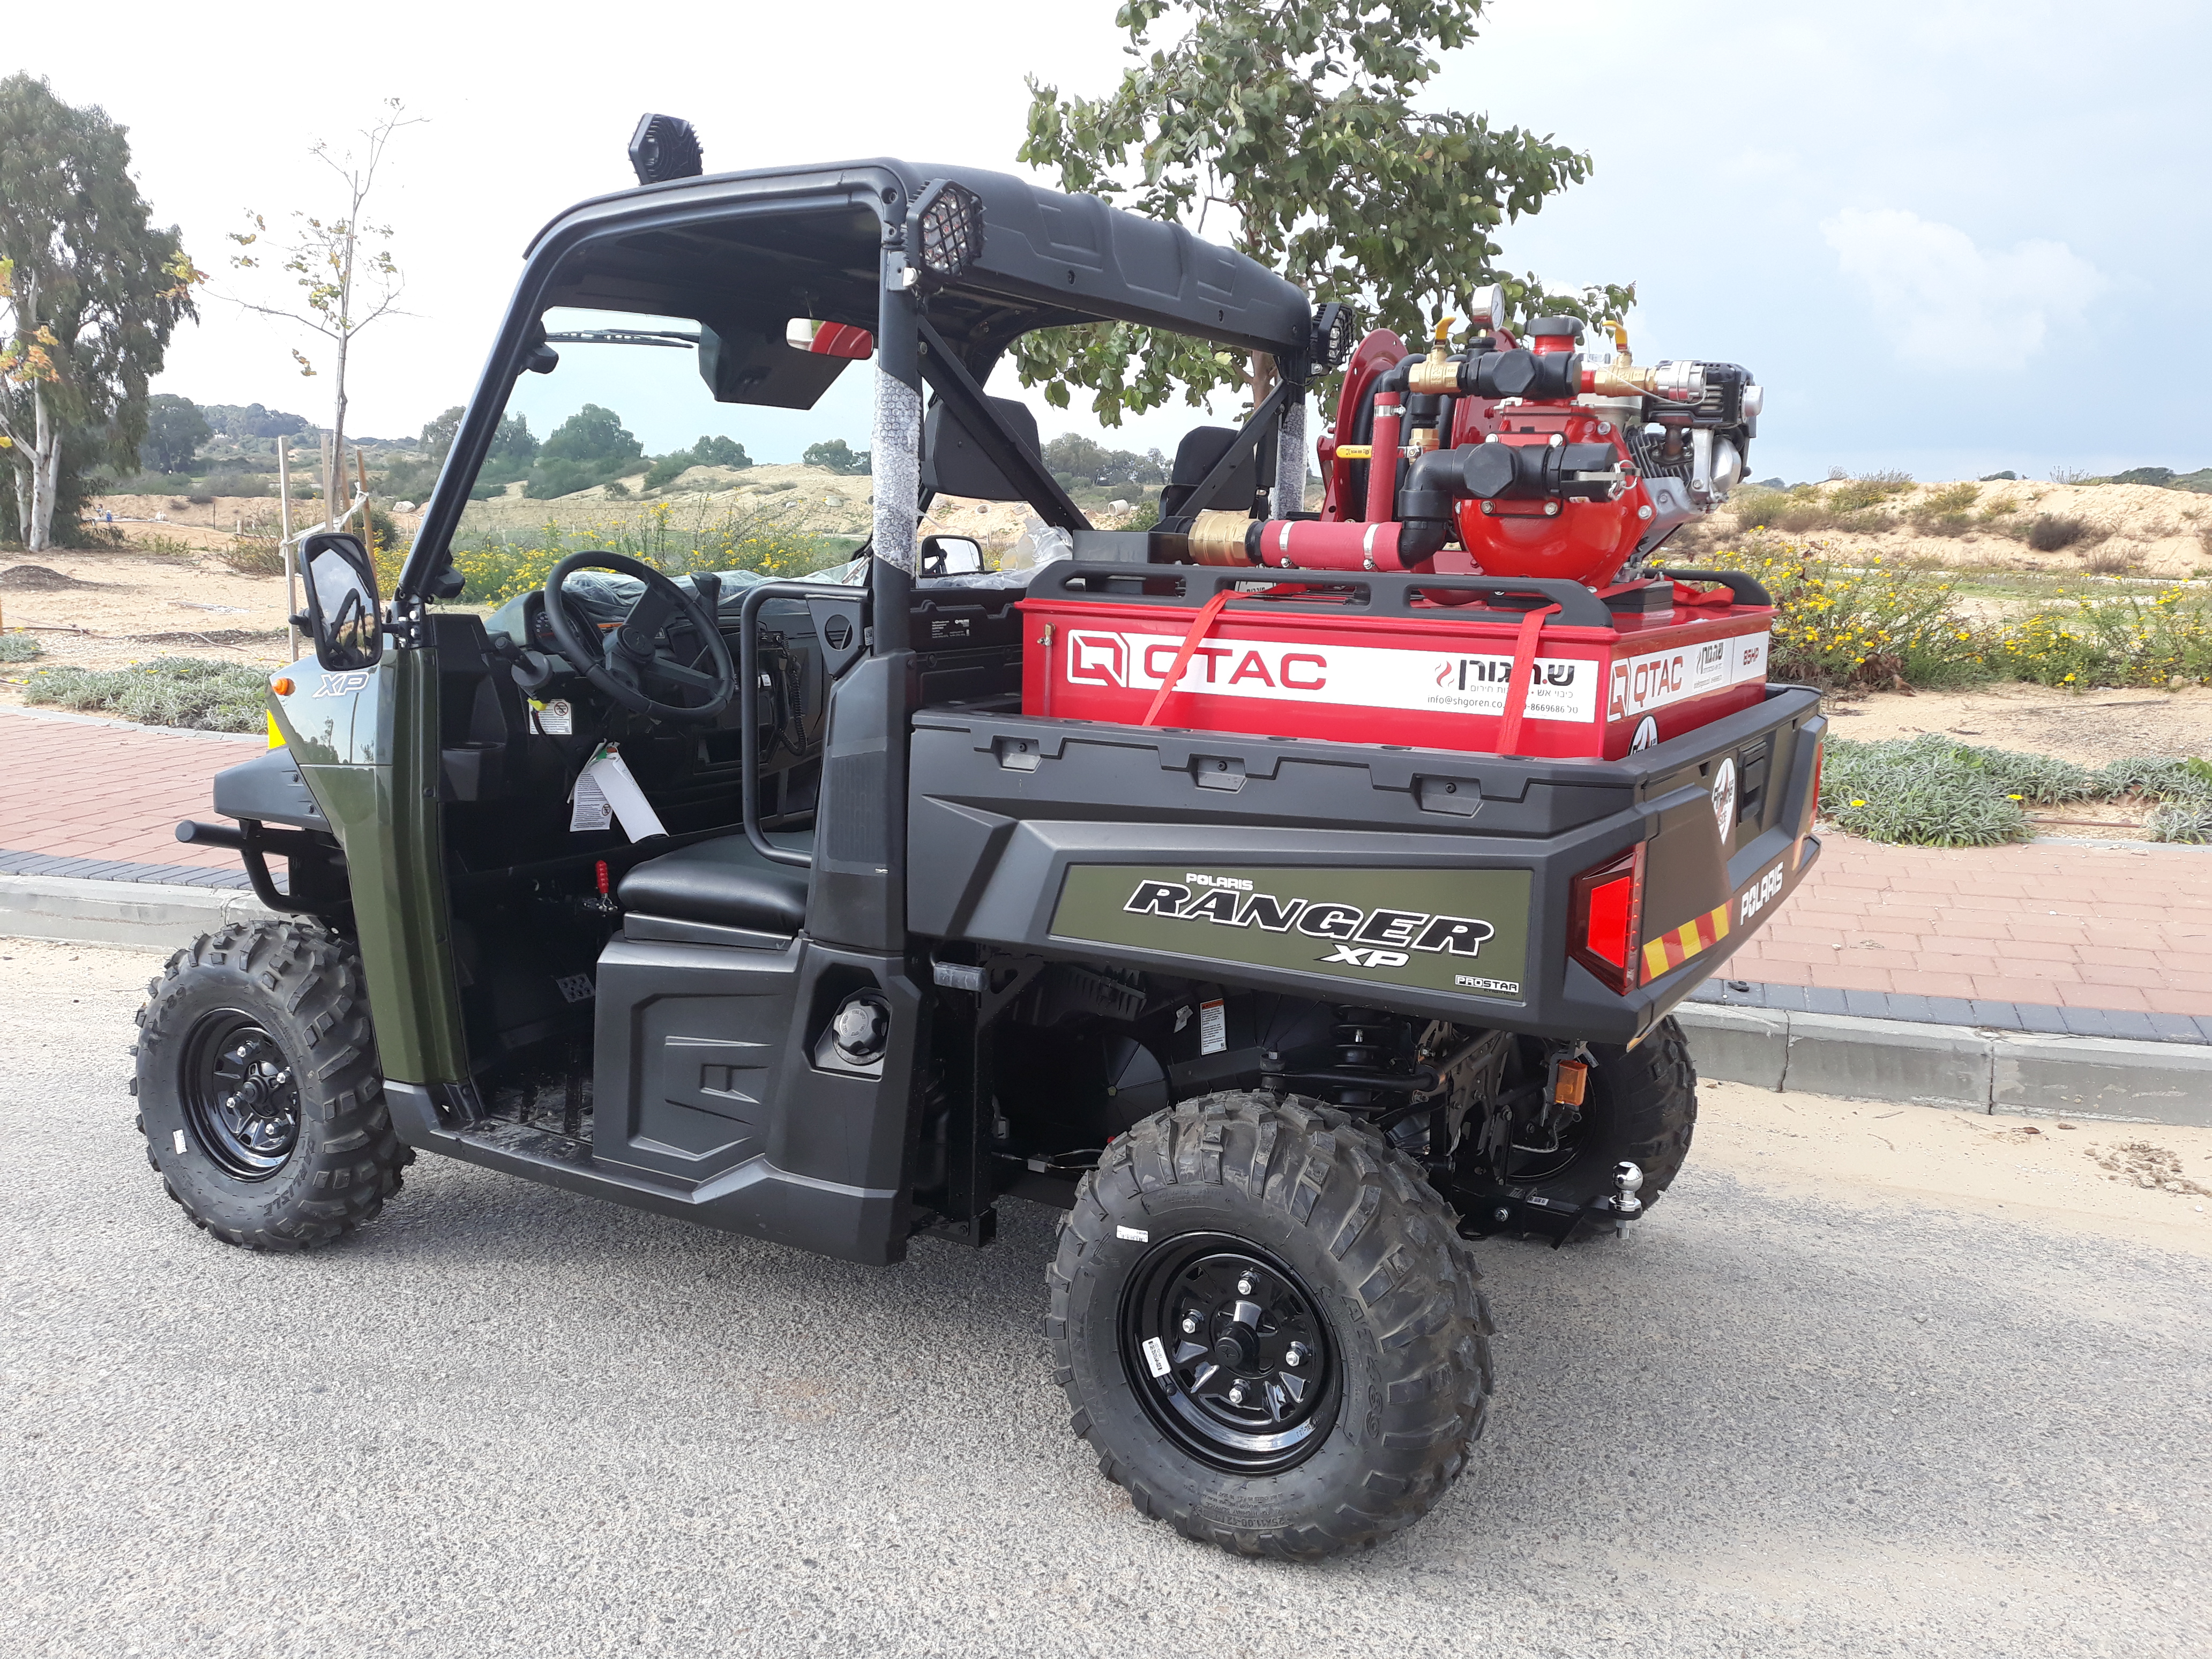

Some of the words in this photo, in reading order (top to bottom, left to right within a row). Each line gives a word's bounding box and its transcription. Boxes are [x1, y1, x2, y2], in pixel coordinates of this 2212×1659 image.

[312, 671, 369, 697] XP
[1634, 656, 1683, 707] QTAC
[1428, 695, 1505, 708] info@shgoren.co.
[1186, 873, 1253, 891] POLARIS
[1740, 861, 1784, 926] POLARIS
[1124, 880, 1494, 958] RANGER
[1314, 944, 1411, 968] XP
[1456, 976, 1518, 991] PROSTAR
